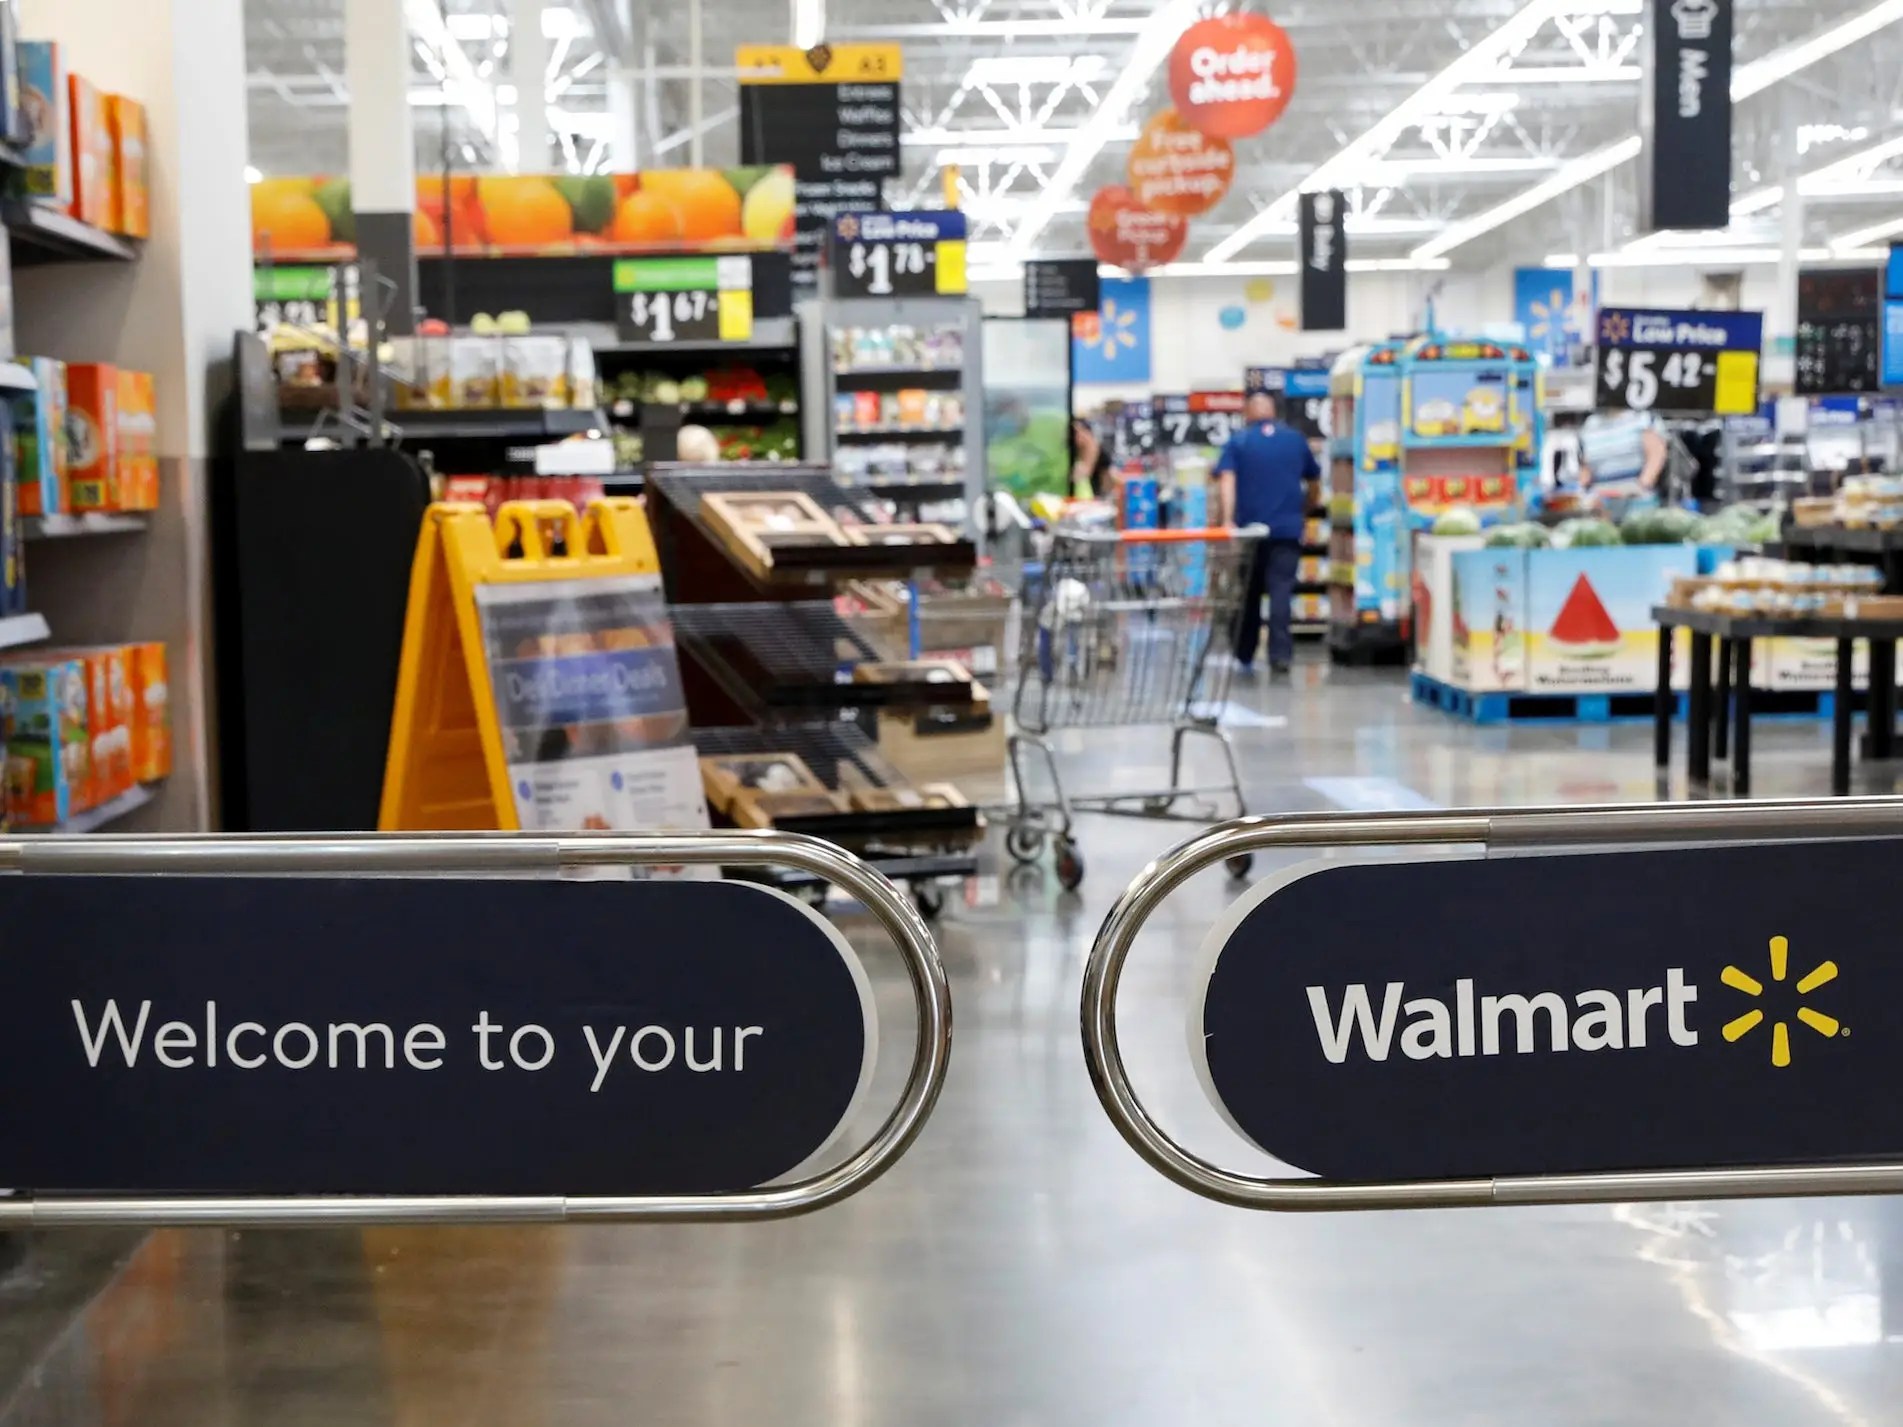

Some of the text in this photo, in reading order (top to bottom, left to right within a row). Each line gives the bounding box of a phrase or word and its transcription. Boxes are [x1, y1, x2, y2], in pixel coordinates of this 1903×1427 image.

[1191, 45, 1276, 77] Order
[1679, 48, 1709, 117] Men
[1189, 74, 1281, 104] ahead.
[1632, 322, 1728, 346] Low Price
[1305, 967, 1698, 1064] Walmart
[72, 999, 763, 1092] Welcome to your
